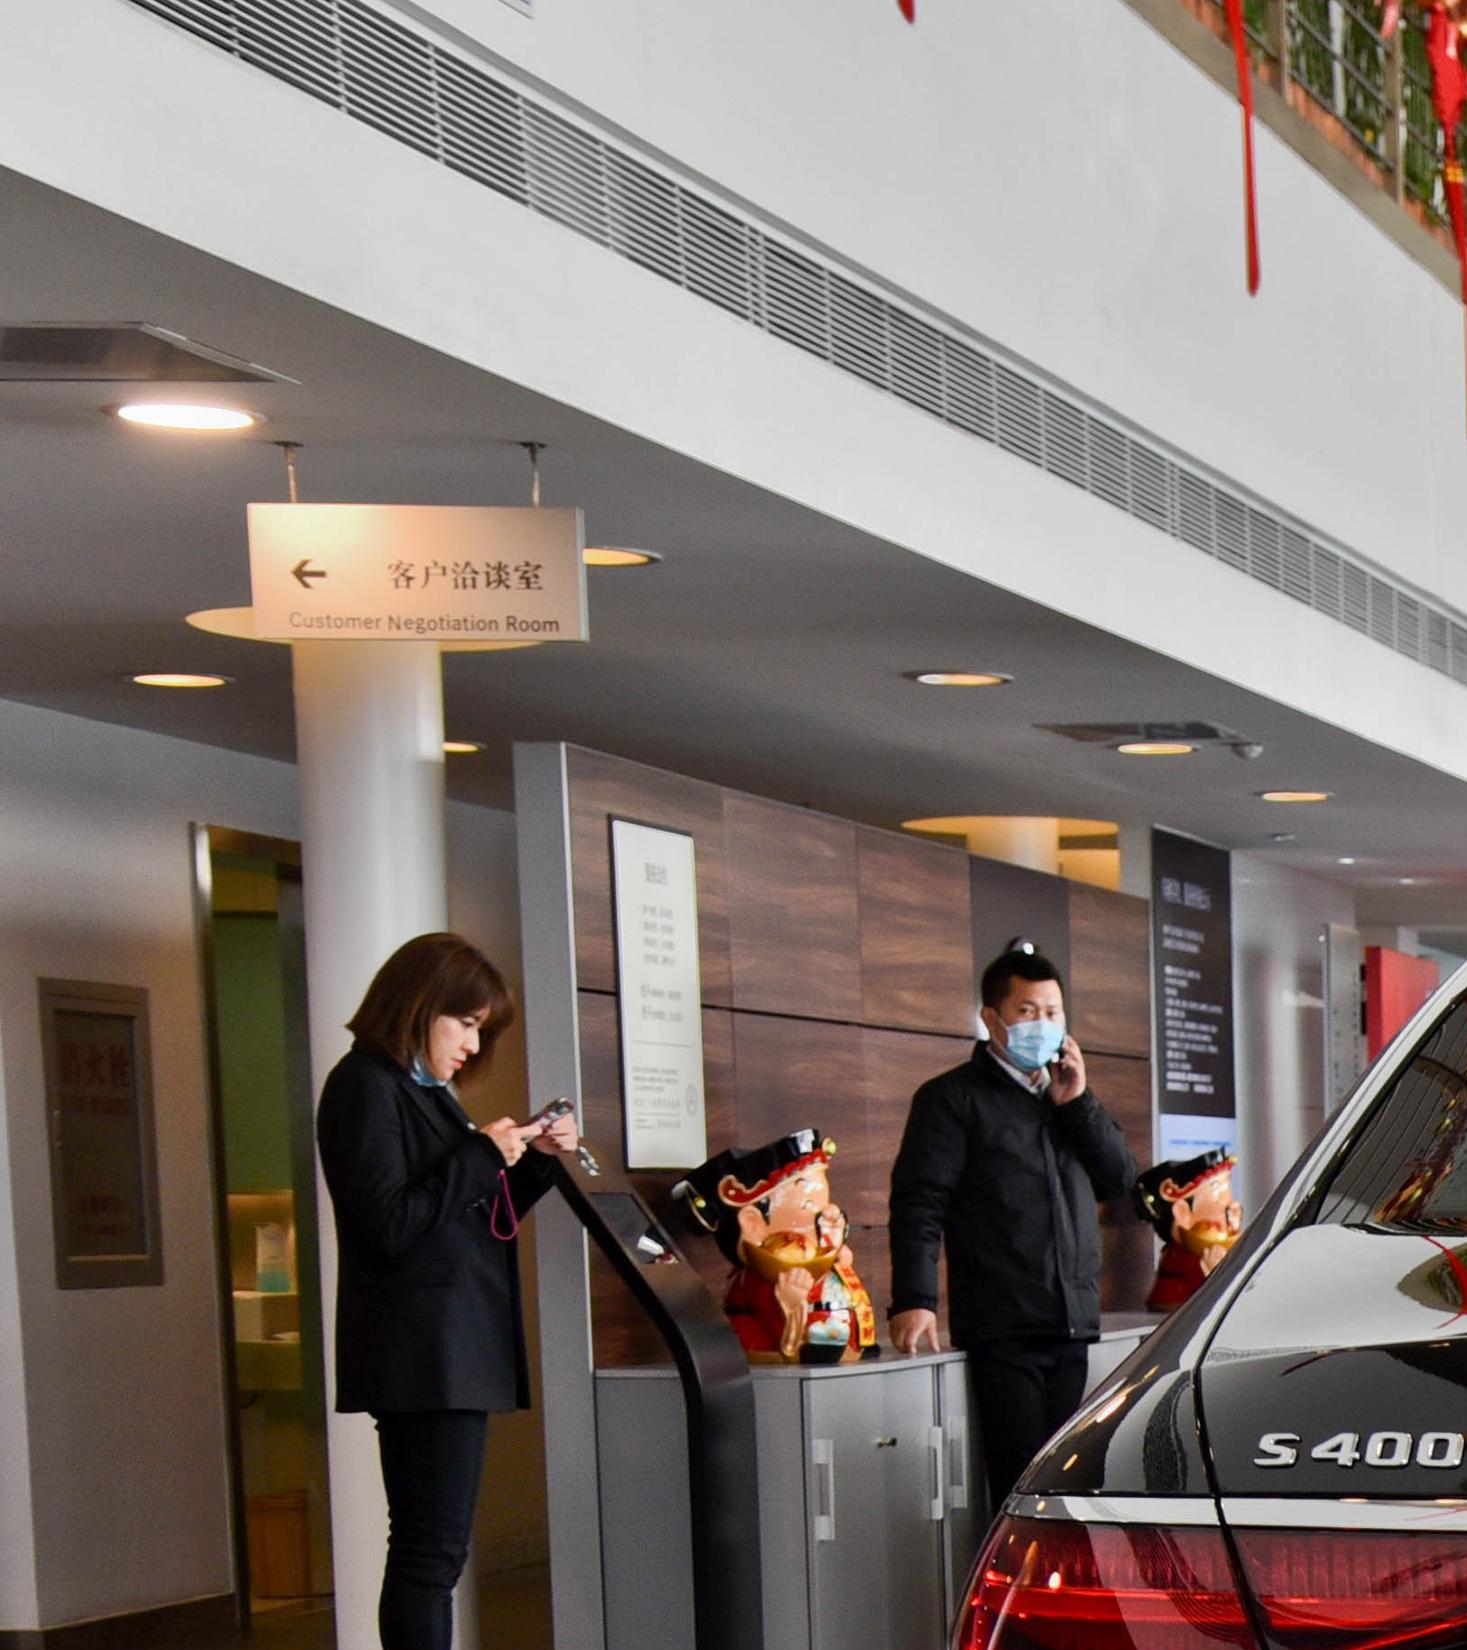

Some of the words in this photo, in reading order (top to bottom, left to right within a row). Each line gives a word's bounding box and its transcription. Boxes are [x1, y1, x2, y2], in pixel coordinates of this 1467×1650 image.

[388, 560, 543, 592] 客户洽谈室
[289, 611, 381, 630] Customer
[388, 615, 499, 634] Negotiation
[506, 615, 560, 633] Room
